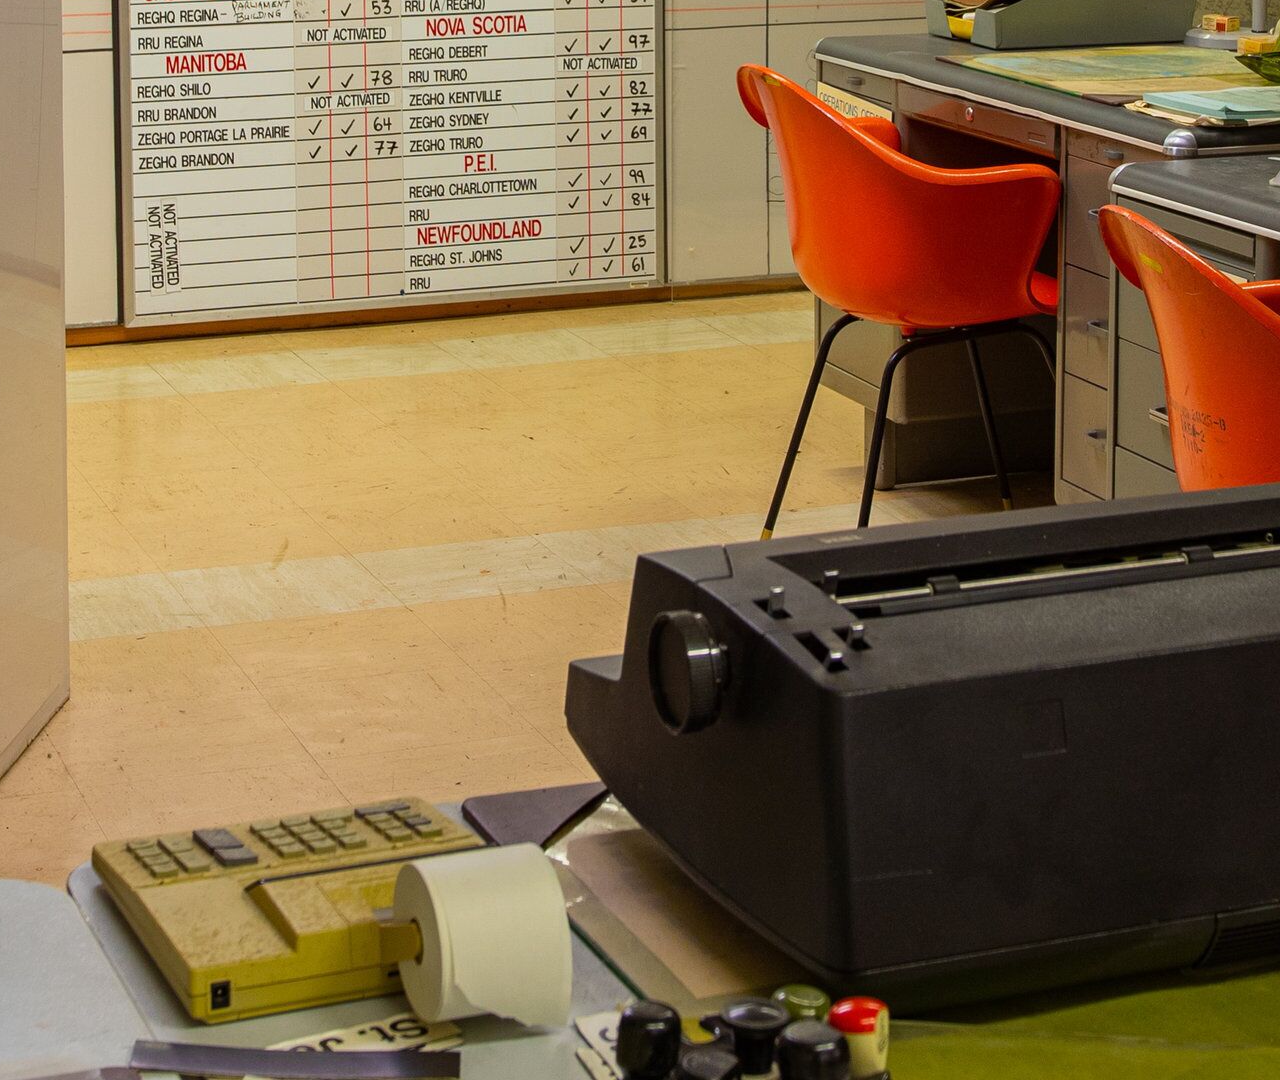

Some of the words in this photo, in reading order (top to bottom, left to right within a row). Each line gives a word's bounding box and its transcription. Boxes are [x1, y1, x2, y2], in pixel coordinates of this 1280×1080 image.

[427, 18, 465, 36] NOVA
[473, 15, 527, 34] SCOTIA
[166, 53, 246, 74] MANITOBA
[371, 70, 392, 86] 78
[410, 93, 444, 106] ZEGHQ
[449, 90, 501, 104] KENTVILLE
[138, 132, 175, 146] ZEGHQ
[180, 129, 228, 143] PORTAGE
[233, 128, 246, 140] LA
[251, 126, 290, 139] PRAIRIE
[465, 154, 496, 172] P.E.I.
[409, 184, 444, 198] REGHQ
[449, 179, 537, 196] CHARLOTTETOWN
[163, 204, 176, 225] NOT
[417, 220, 542, 245] NEWFOUNDLAND
[165, 231, 179, 285] ACTIVATED
[410, 253, 445, 267] REGHQ
[450, 252, 464, 264] ST.
[469, 249, 502, 263] JOHNS
